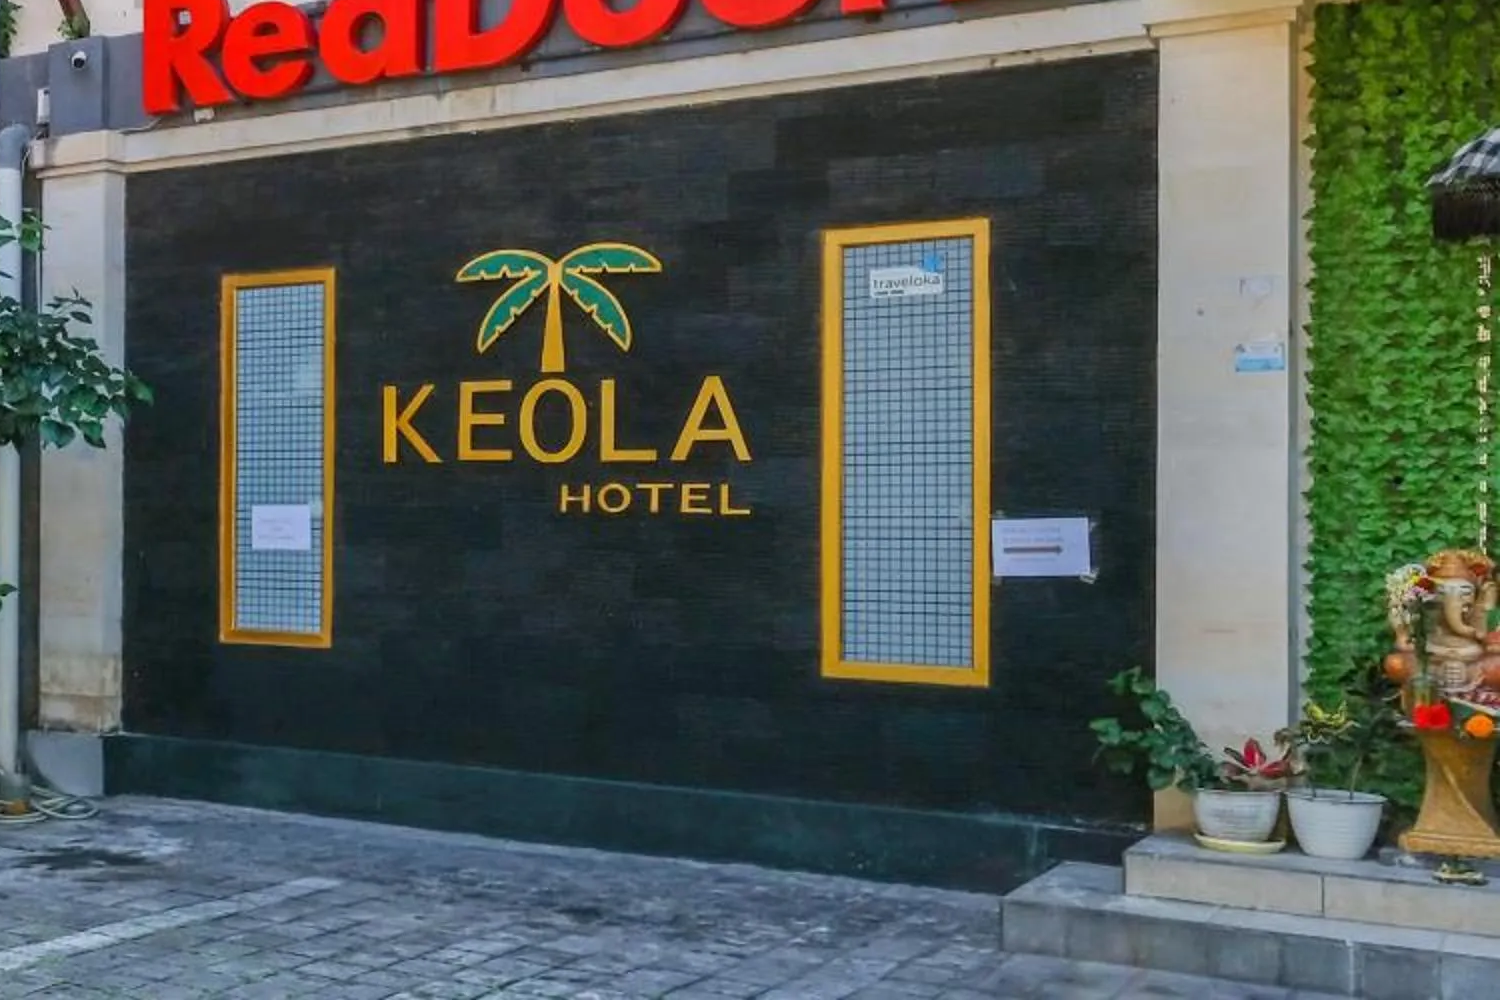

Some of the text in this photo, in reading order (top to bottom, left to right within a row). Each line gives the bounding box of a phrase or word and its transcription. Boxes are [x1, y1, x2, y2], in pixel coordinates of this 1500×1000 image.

[873, 274, 941, 289] traveloka
[382, 374, 753, 464] KEOLA
[558, 482, 753, 516] HOTEL
